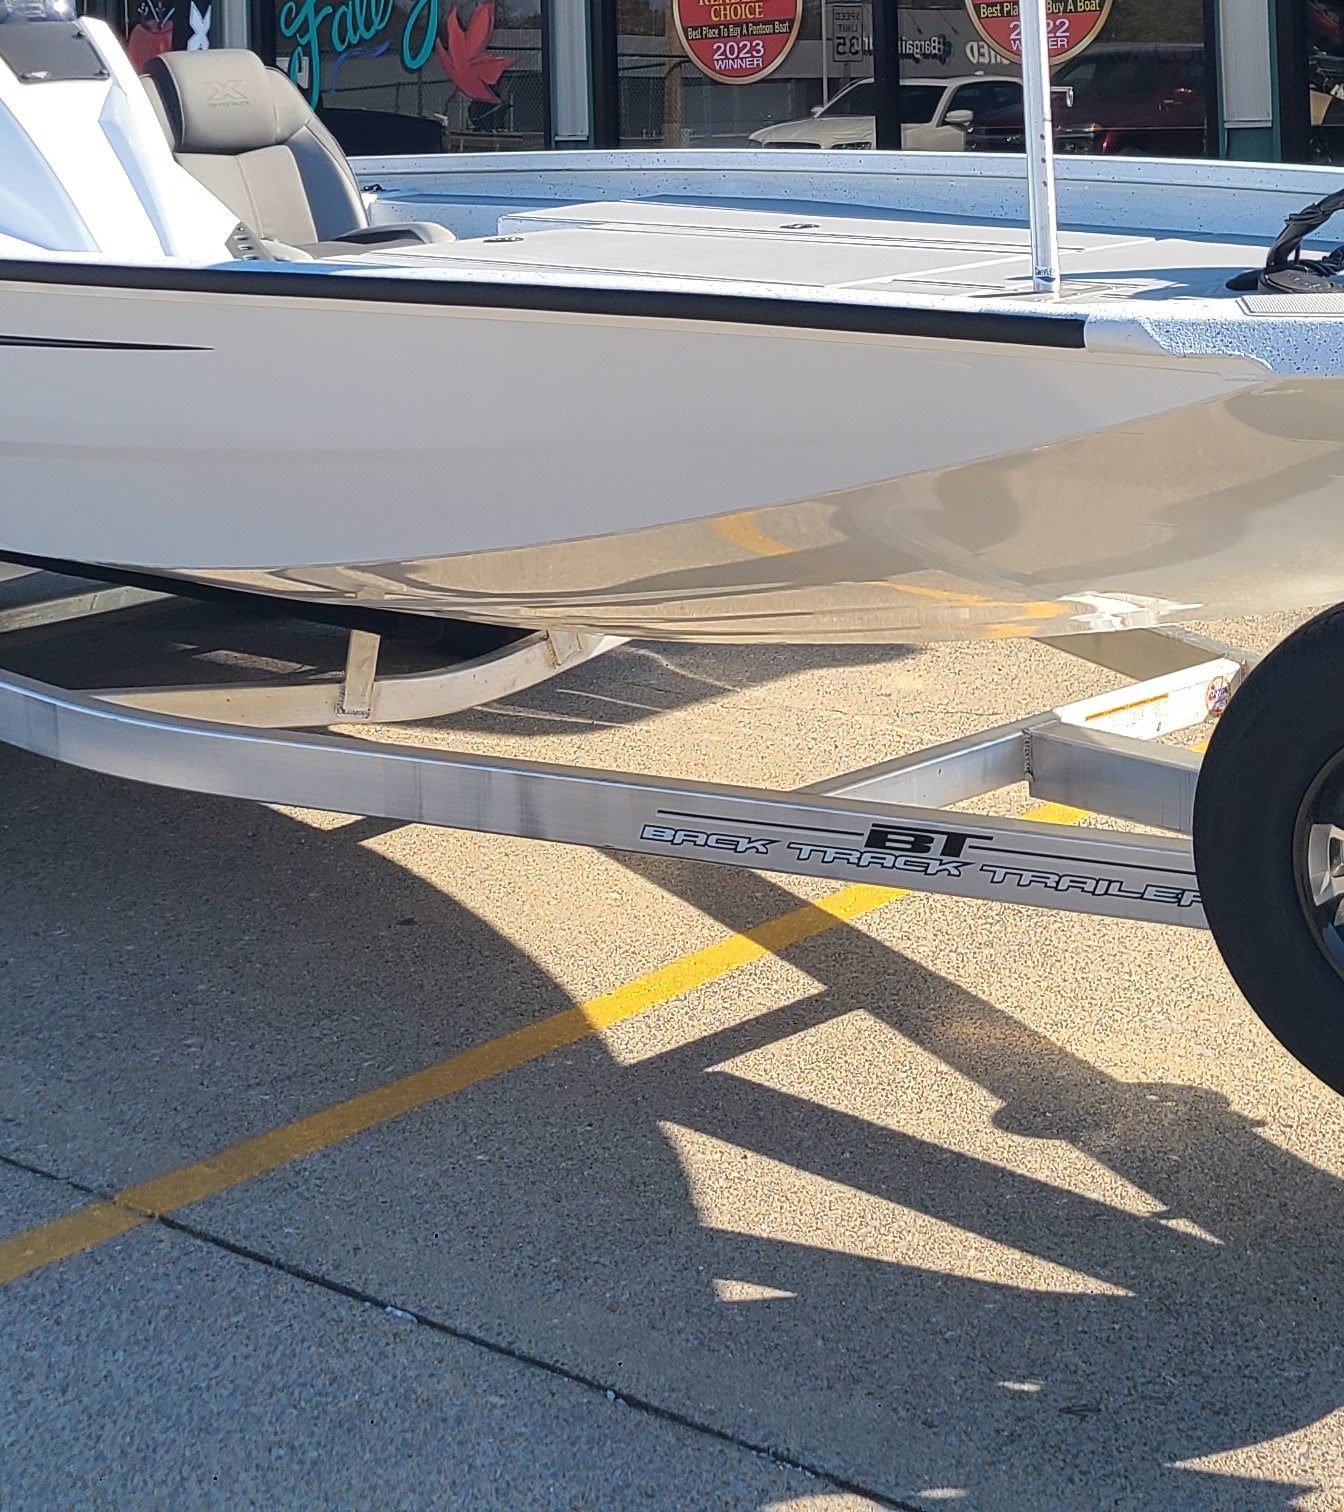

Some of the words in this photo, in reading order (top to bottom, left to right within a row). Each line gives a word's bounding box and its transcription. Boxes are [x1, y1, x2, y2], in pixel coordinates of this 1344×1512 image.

[711, 3, 763, 20] CHOICE
[980, 4, 1001, 18] Best
[1003, 1, 1019, 16] Pla
[1047, 0, 1064, 16] Buy
[1067, 0, 1074, 12] A
[688, 28, 701, 39] Best
[703, 27, 719, 38] Place
[720, 26, 728, 36] To
[730, 24, 741, 38] Buy
[742, 25, 748, 35] A
[749, 22, 773, 34] Pontoon
[775, 21, 789, 33] Boat
[713, 40, 764, 59] 2023
[714, 58, 762, 70] WINNER
[865, 823, 994, 858] BT
[640, 824, 782, 854] BACK
[787, 842, 975, 877] TRACK
